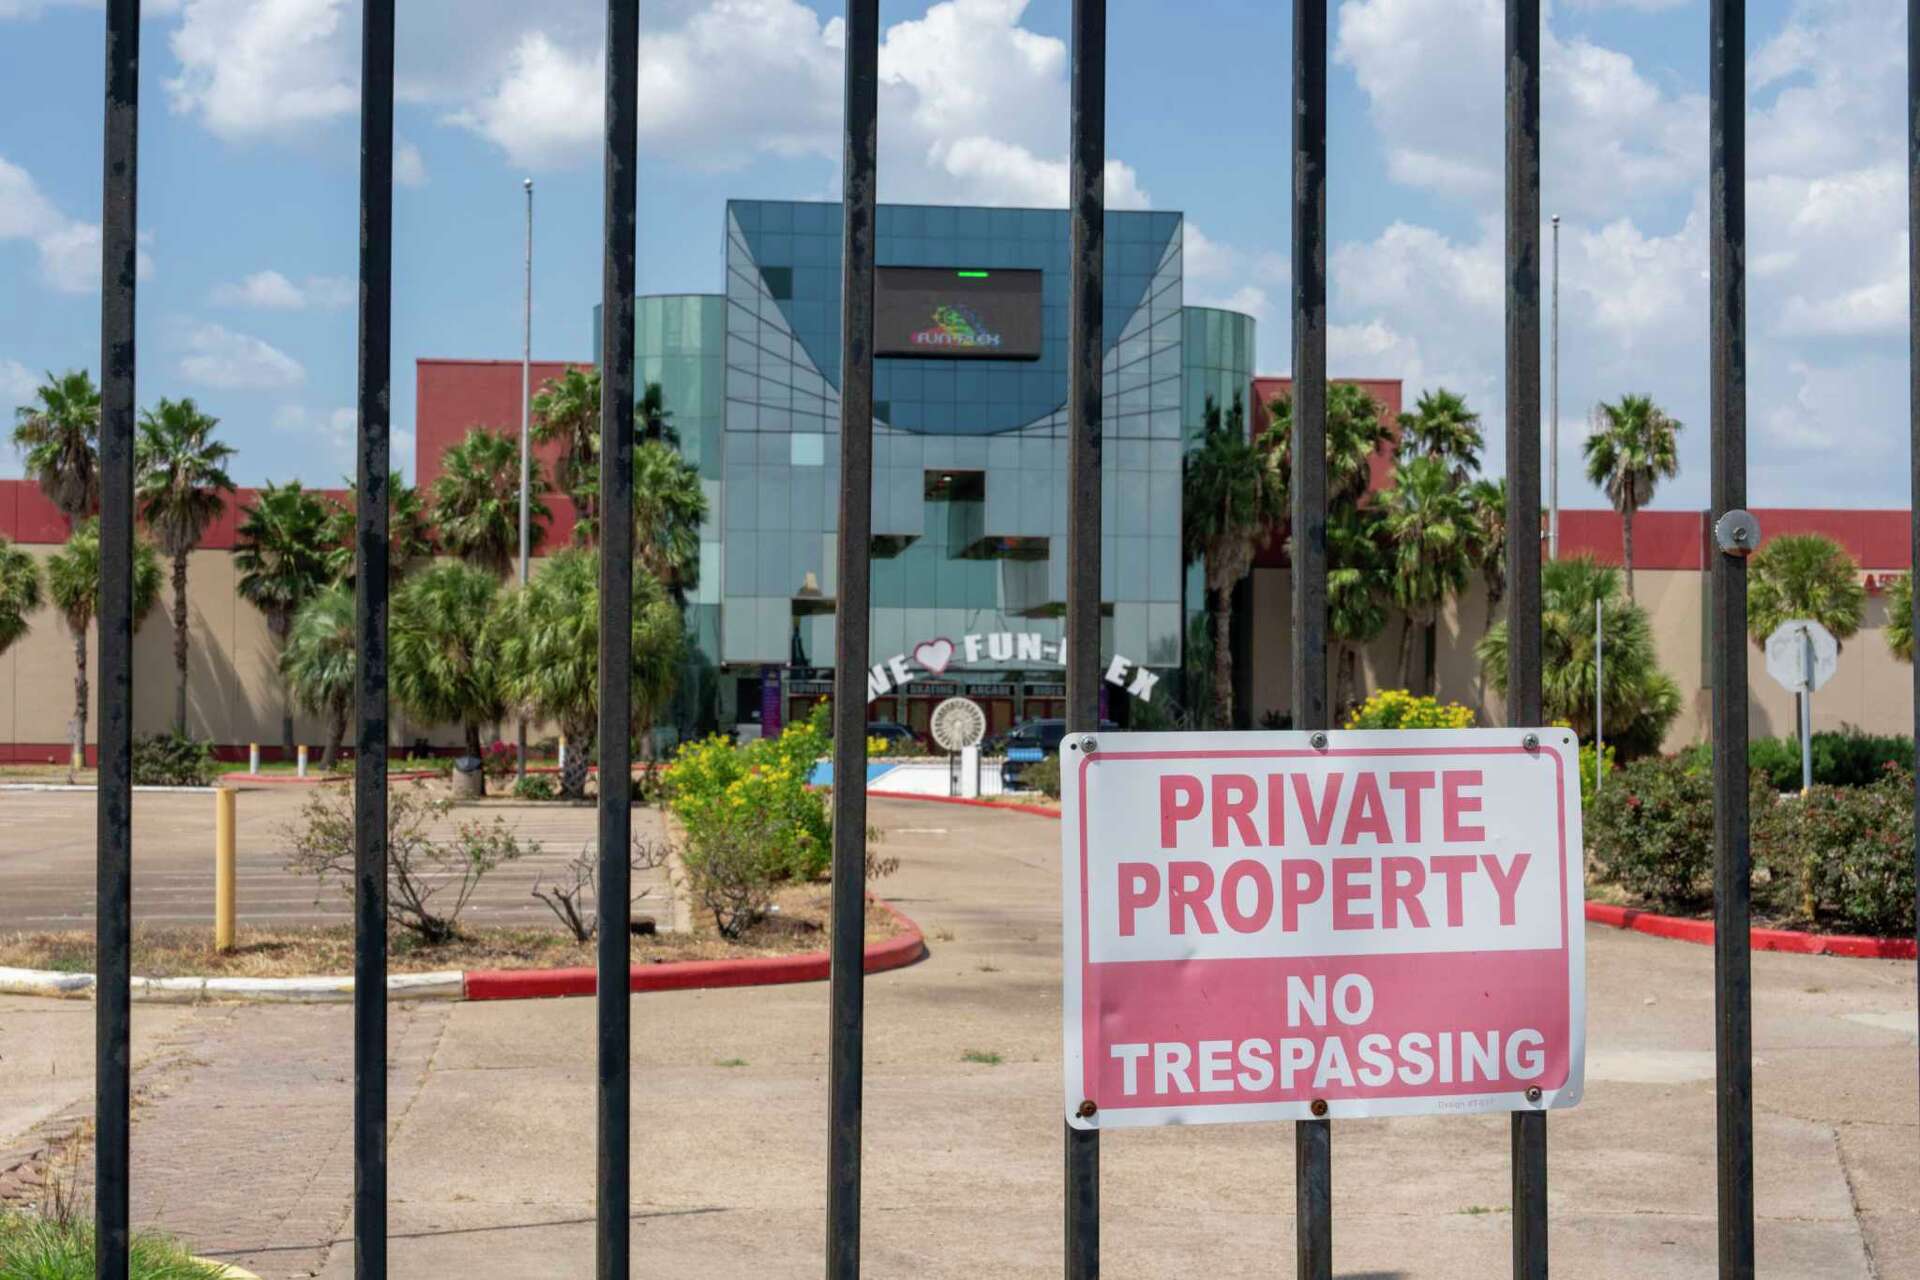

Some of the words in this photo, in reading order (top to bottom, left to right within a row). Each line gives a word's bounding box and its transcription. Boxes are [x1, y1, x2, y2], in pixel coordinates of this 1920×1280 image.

[1159, 770, 1486, 848] PRIVATE
[1117, 853, 1532, 937] PROPERTY
[1286, 973, 1374, 1027] NO
[1110, 1029, 1545, 1096] TRESPASSING
